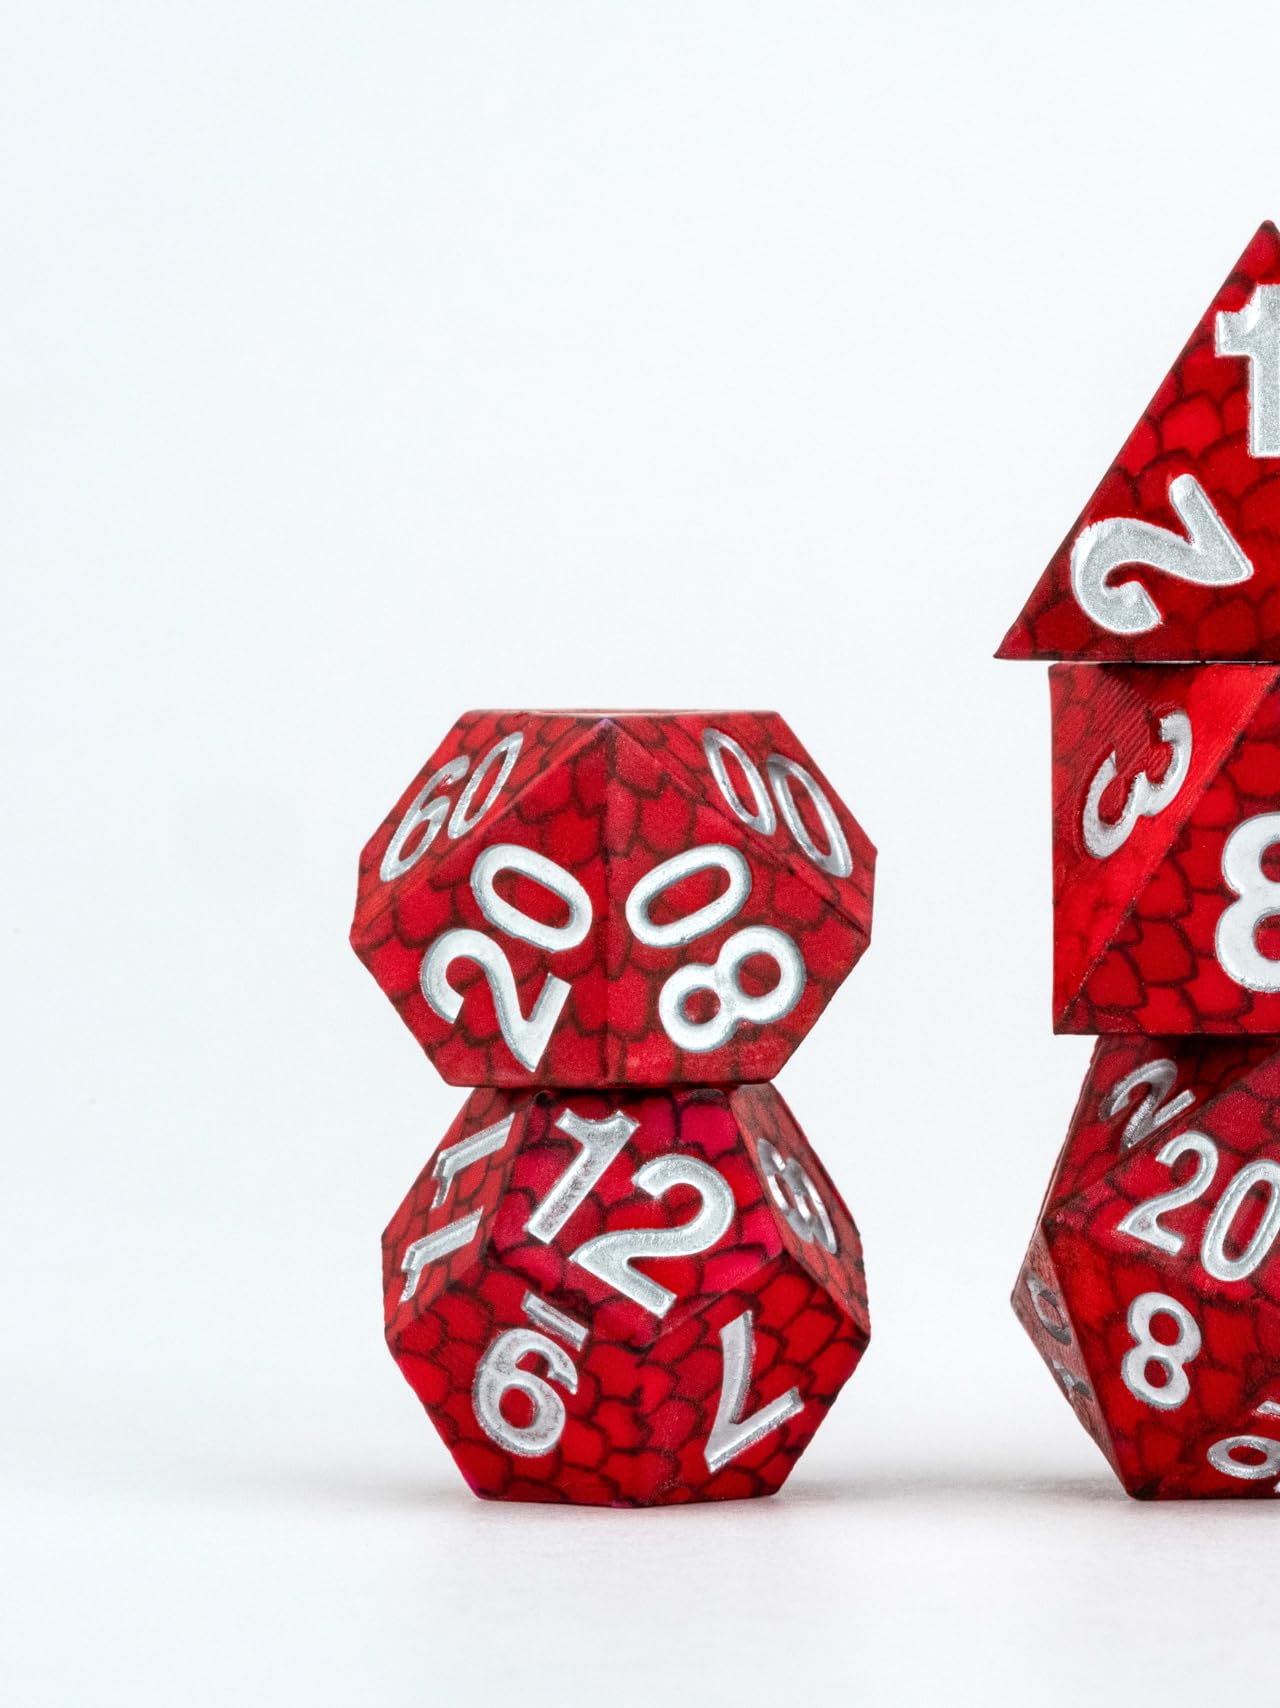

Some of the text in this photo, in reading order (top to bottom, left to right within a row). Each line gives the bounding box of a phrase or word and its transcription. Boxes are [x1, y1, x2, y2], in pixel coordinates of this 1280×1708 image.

[1068, 472, 1255, 636] 2
[378, 730, 525, 884] 60
[702, 727, 855, 879] 00
[1081, 710, 1194, 860] 3
[418, 842, 594, 1074] 20
[623, 842, 808, 1055] 80
[1099, 1057, 1197, 1152] 2
[522, 1107, 738, 1320] 12
[703, 1309, 805, 1474] 7
[1120, 1291, 1203, 1411] 8
